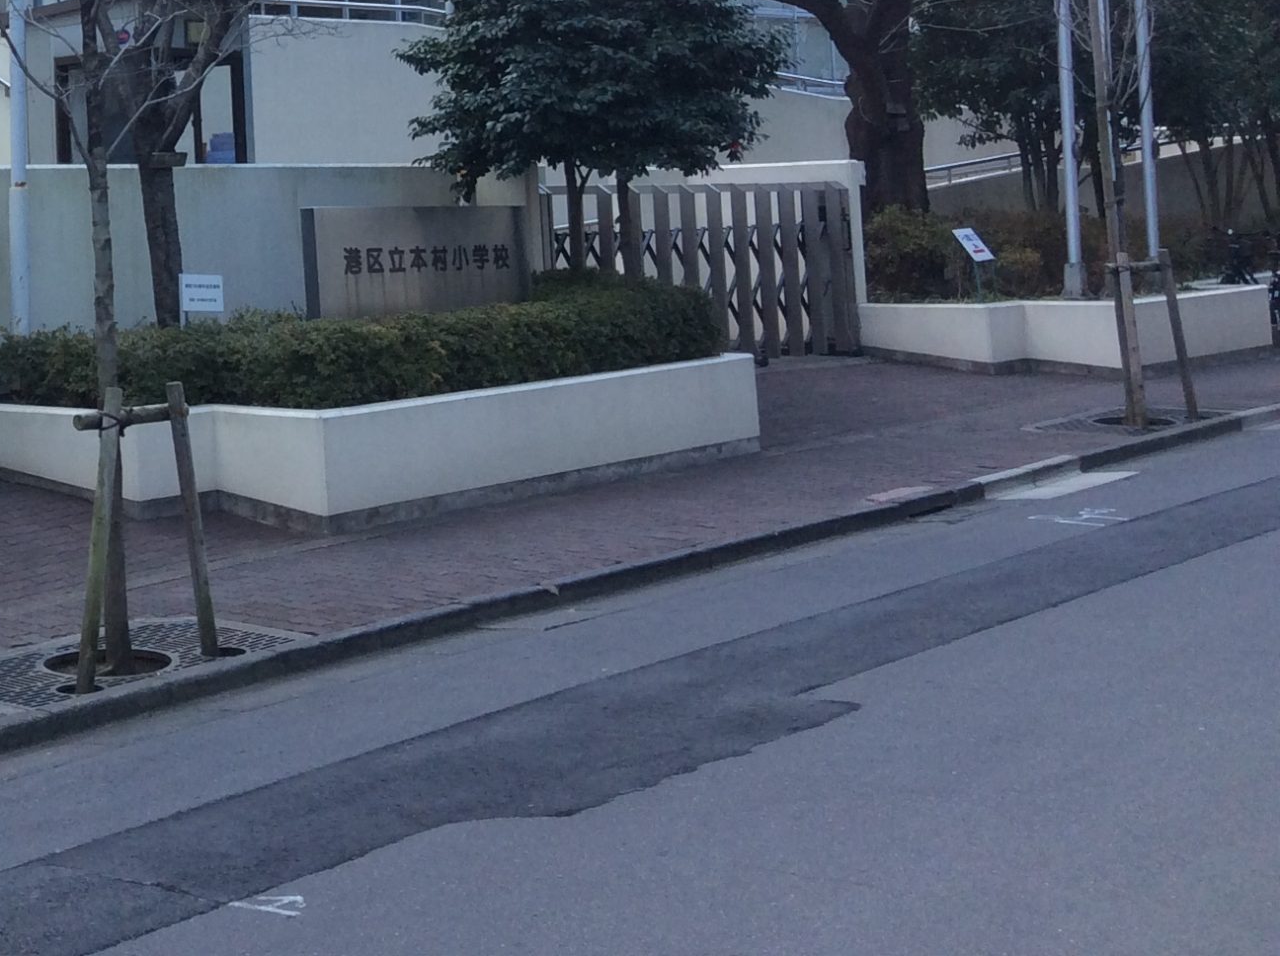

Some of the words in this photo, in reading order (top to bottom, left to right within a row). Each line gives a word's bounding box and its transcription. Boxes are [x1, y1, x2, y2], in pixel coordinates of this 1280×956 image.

[343, 245, 510, 275] 港区立本村小学校
